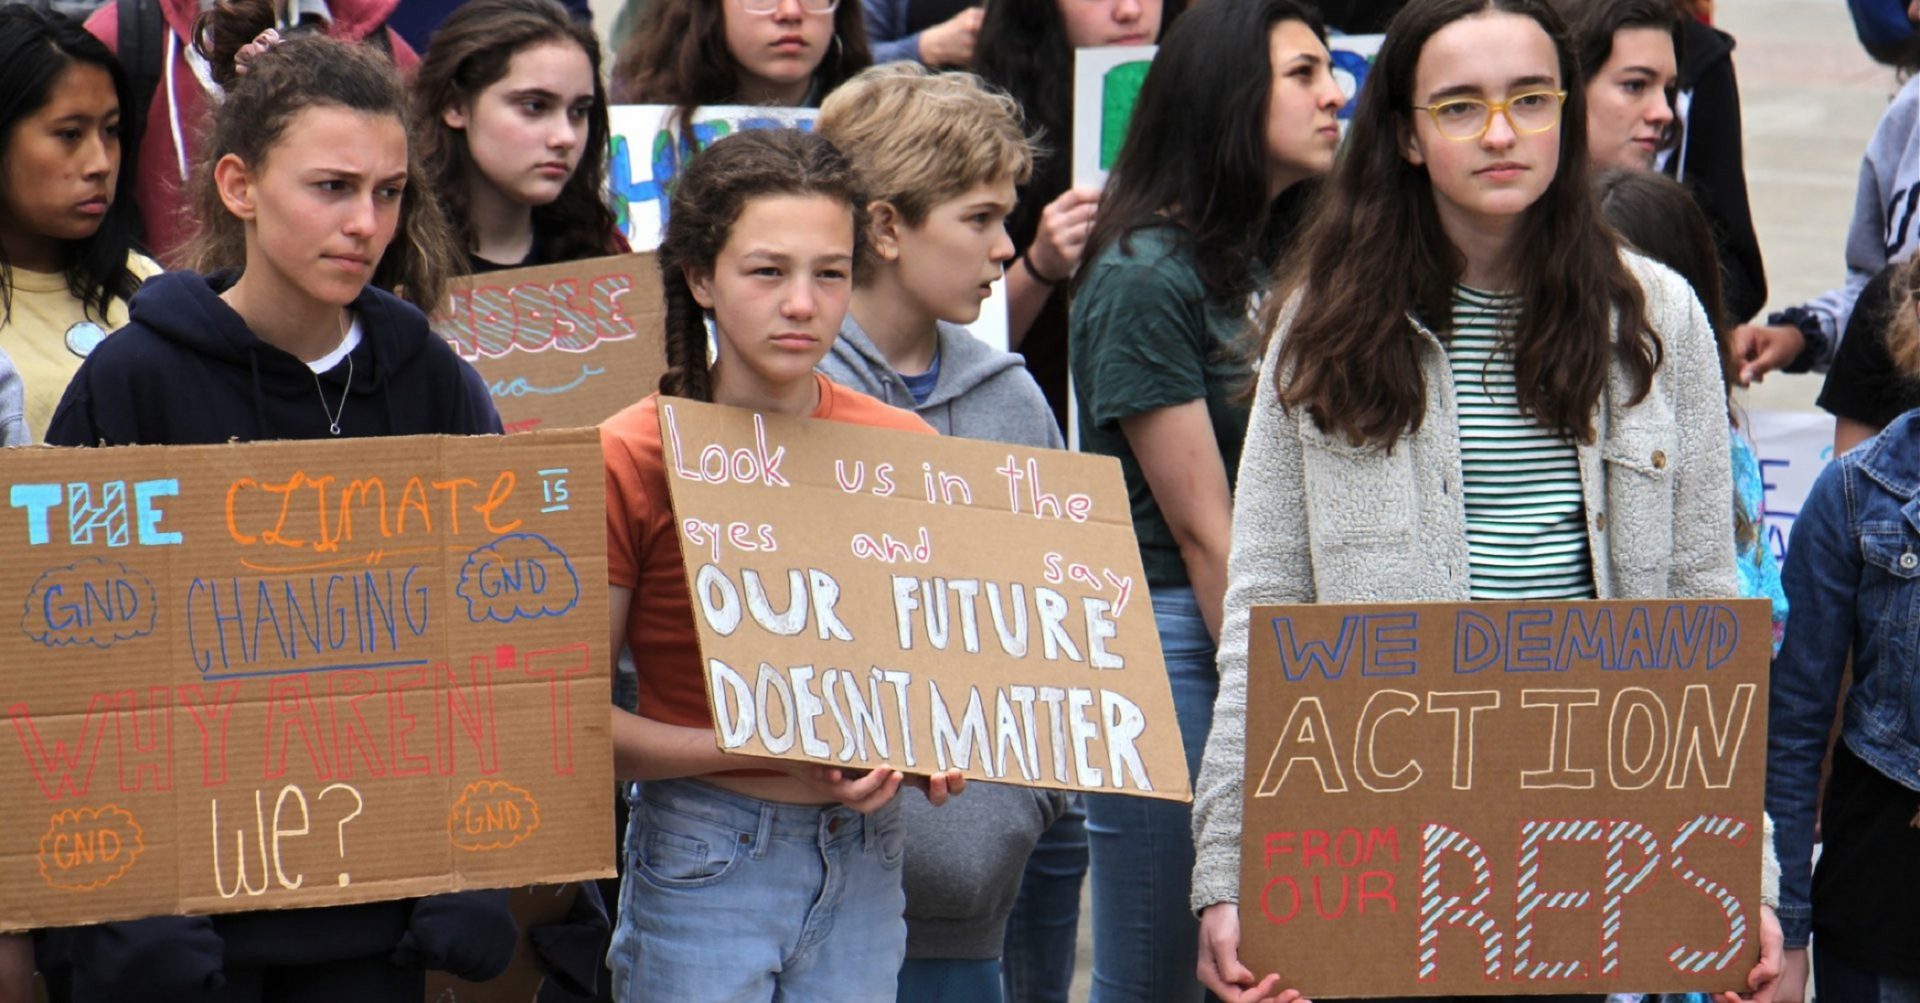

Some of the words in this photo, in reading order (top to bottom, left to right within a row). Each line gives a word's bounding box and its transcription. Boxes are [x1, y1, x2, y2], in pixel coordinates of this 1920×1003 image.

[663, 405, 789, 488] Look
[835, 458, 895, 496] us
[922, 461, 973, 505] in
[996, 454, 1092, 522] the
[10, 479, 183, 546] THE
[42, 580, 139, 631] GND
[478, 557, 547, 598] GND
[683, 518, 777, 563] eyes
[851, 527, 931, 563] and
[1043, 552, 1132, 618] say
[187, 565, 428, 673] CHANGING
[696, 563, 854, 642] OUR
[892, 574, 1125, 670] FUTURE
[1272, 612, 1420, 682] WE
[1453, 605, 1739, 676] DEMAND
[8, 679, 241, 800] WHY
[263, 643, 591, 781] AREN'T
[708, 657, 916, 768] DOESN'T
[929, 679, 1154, 792] MATTER
[1254, 683, 1757, 799] ACTION
[52, 829, 121, 871] GND
[463, 798, 522, 834] GND
[1263, 825, 1400, 870] FROM
[1259, 870, 1397, 926] OUR
[1415, 814, 1754, 985] REPS
